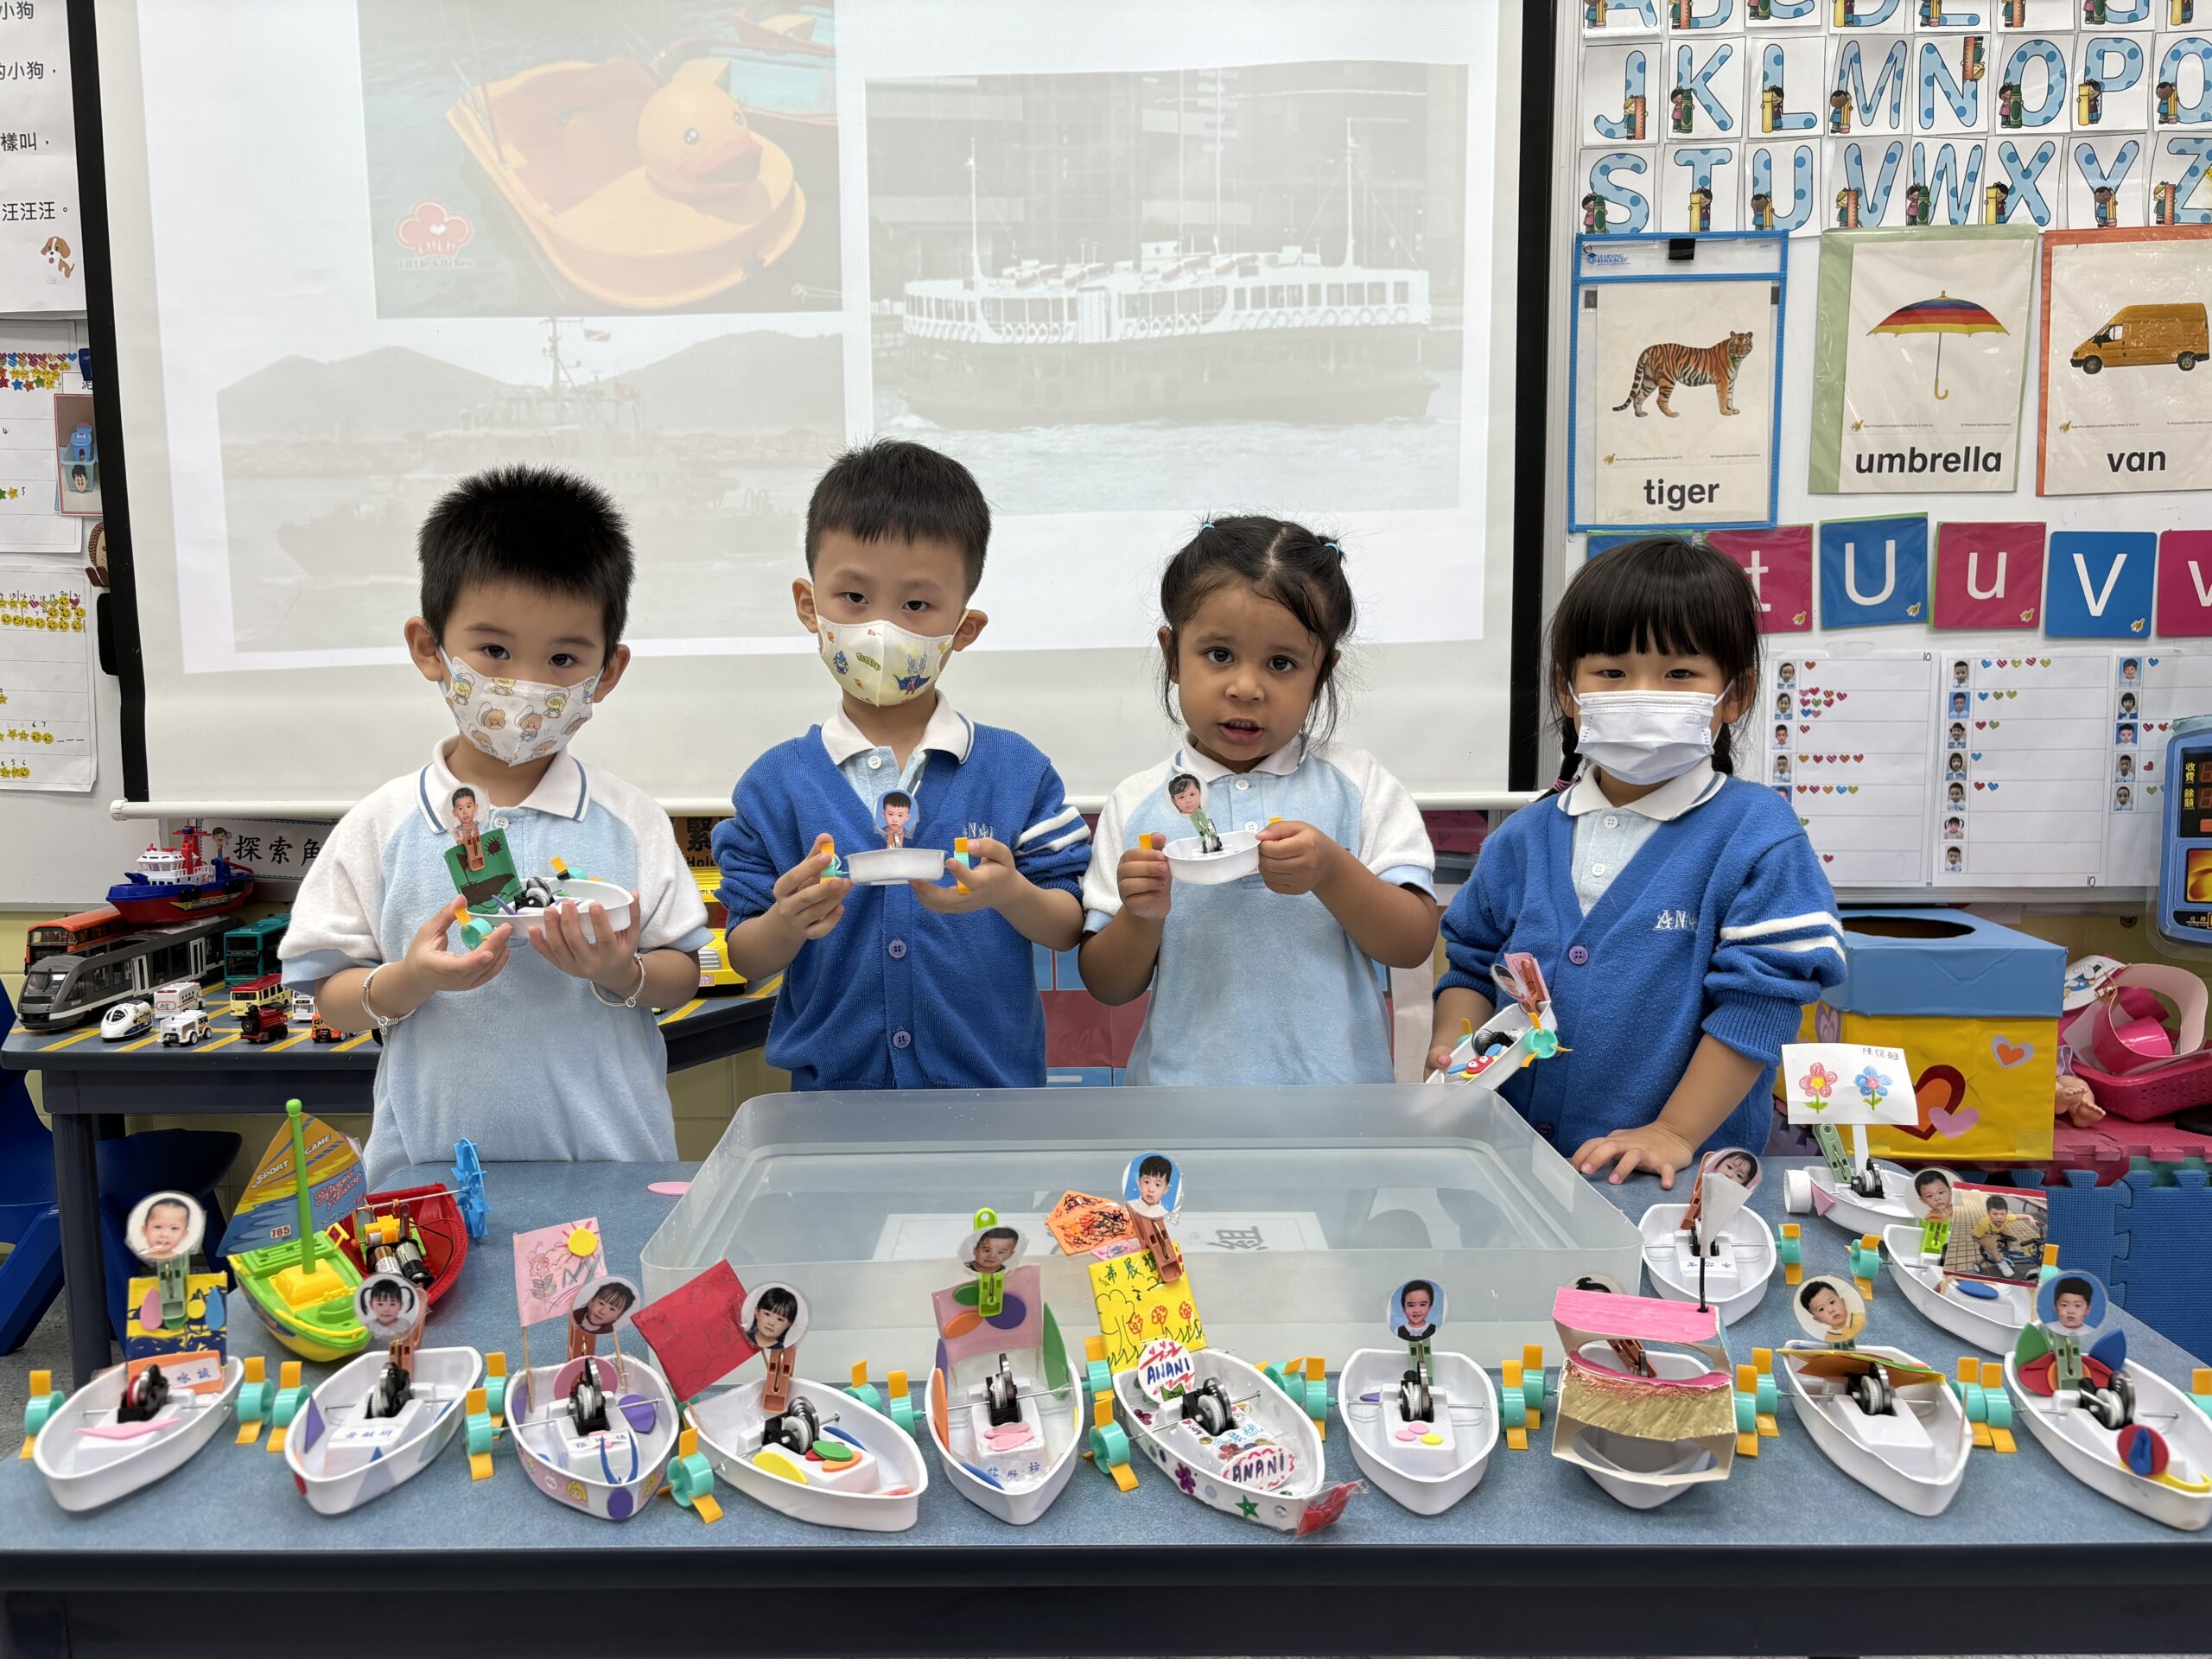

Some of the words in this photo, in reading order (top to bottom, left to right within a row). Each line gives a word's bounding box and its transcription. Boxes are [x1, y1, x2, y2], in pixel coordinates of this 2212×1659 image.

[1595, 50, 1645, 138] J
[1677, 43, 1734, 131] K
[1766, 43, 1818, 130] L
[1834, 40, 1908, 130] M
[2000, 39, 2065, 127] O
[2083, 37, 2144, 124] P
[1856, 446, 2002, 474] umbrella
[2107, 450, 2166, 473] van
[1643, 479, 1720, 512] tiger
[1845, 539, 1896, 607] U
[1967, 551, 2007, 601] u
[2073, 553, 2127, 617] V
[233, 835, 321, 866] 探索角
[305, 1134, 332, 1155] GAME
[251, 1160, 289, 1189] SPORT
[270, 1227, 290, 1237] 785
